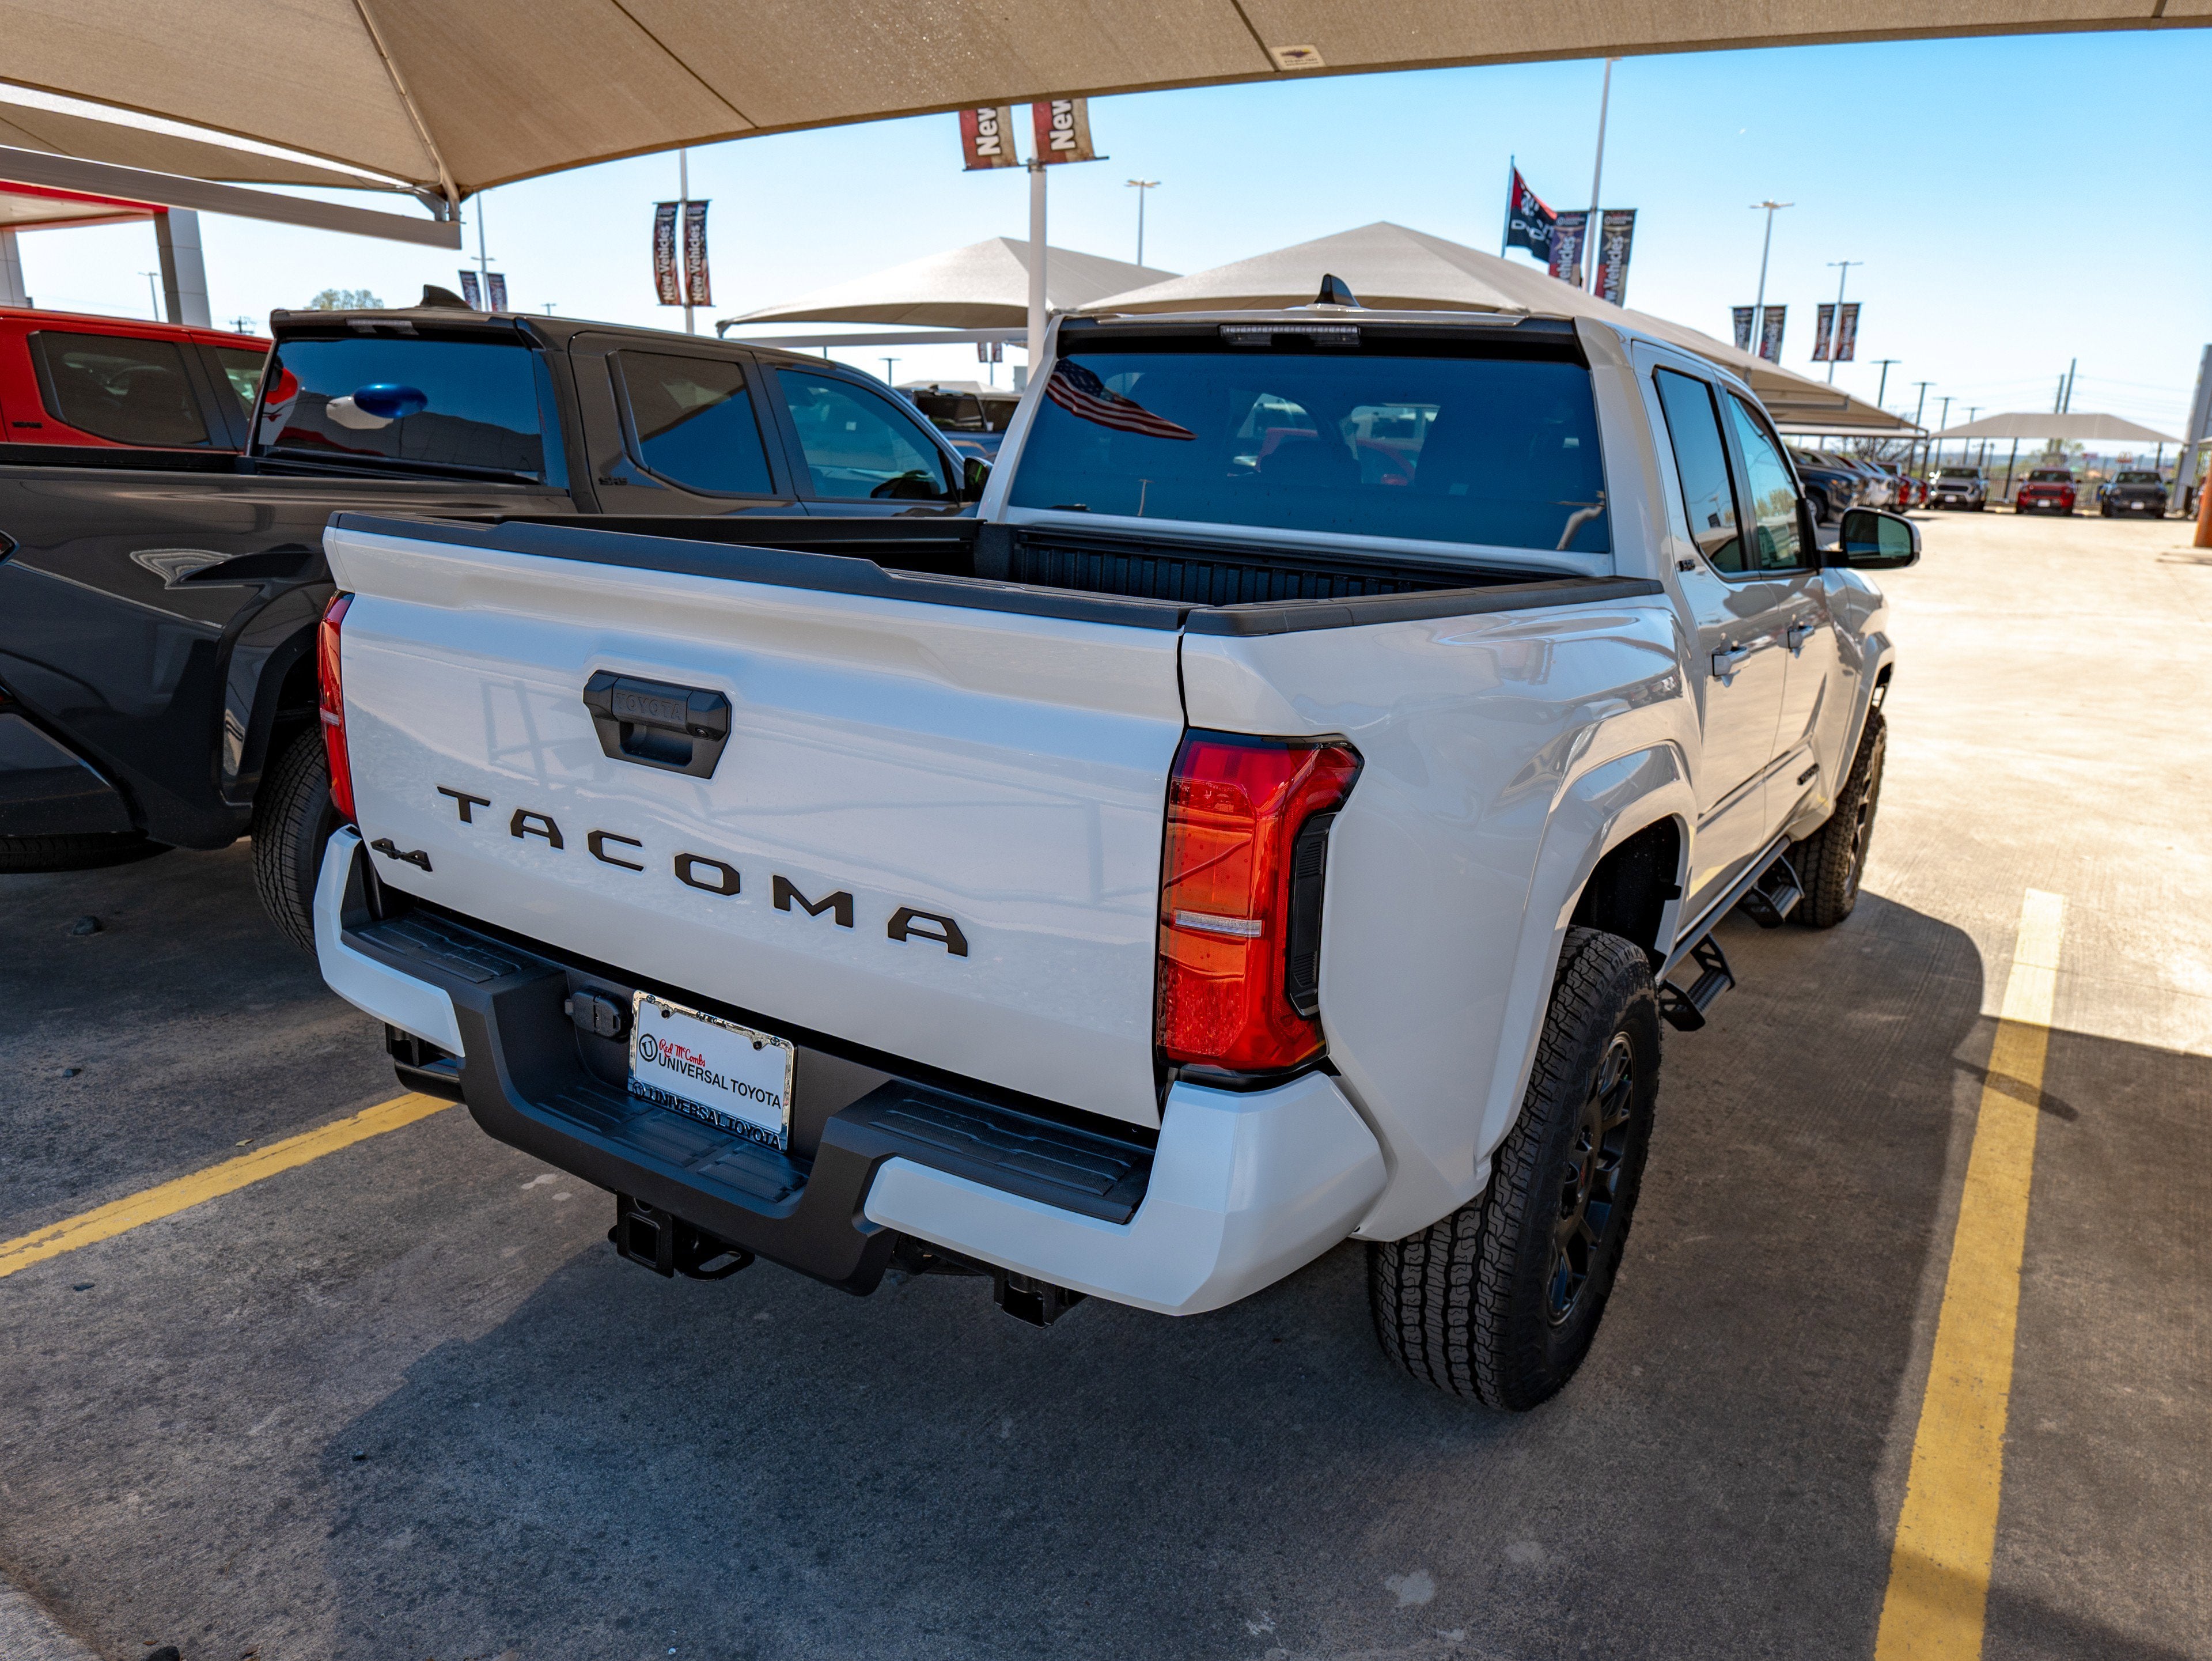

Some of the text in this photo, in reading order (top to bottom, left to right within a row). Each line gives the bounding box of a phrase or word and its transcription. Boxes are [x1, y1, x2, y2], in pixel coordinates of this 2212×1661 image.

[658, 225, 671, 273] Vehicles
[688, 225, 701, 273] Vehicles
[1604, 236, 1624, 288] Vehicles
[662, 275, 676, 301] New
[691, 275, 705, 301] New
[616, 693, 682, 721] TOYOTA
[437, 785, 968, 957] TACOMA
[659, 1039, 705, 1067] Red McCombs
[658, 1053, 781, 1110] UNIVERSAL TOYOTA
[649, 1087, 726, 1127] UNIVERSAL
[727, 1115, 782, 1151] TOYOTA
